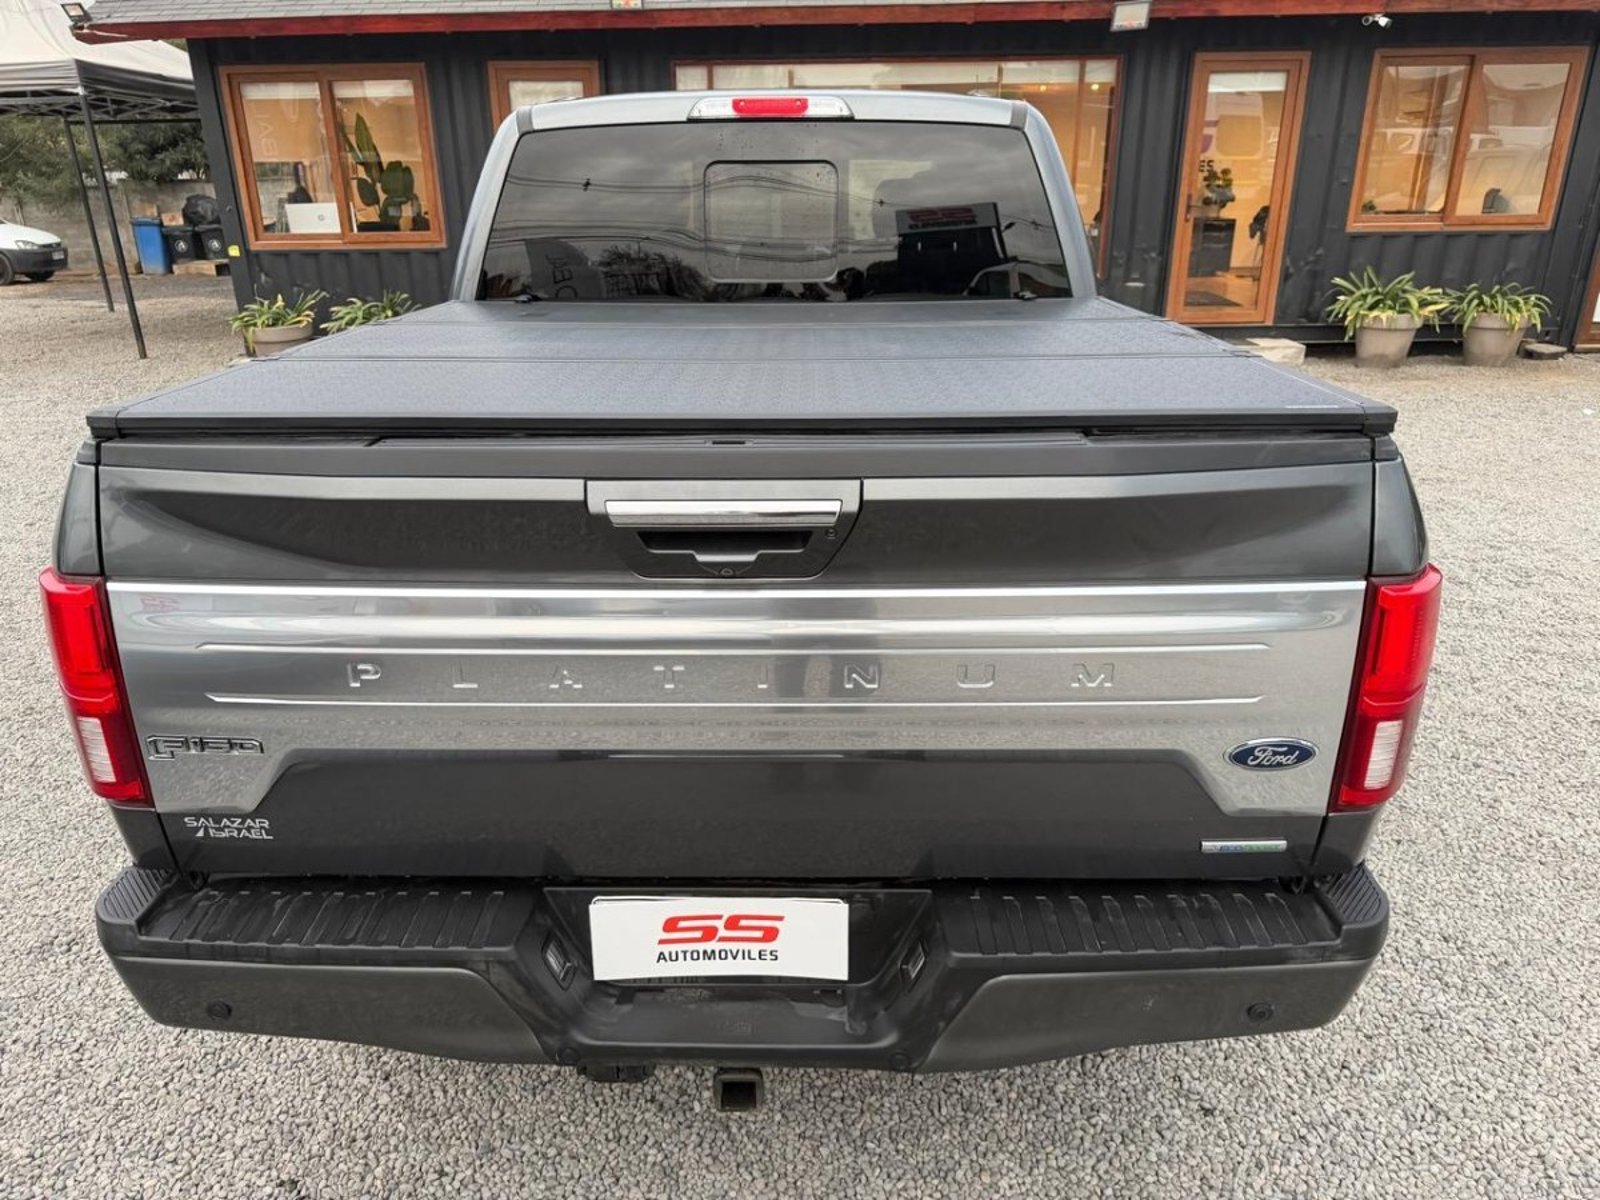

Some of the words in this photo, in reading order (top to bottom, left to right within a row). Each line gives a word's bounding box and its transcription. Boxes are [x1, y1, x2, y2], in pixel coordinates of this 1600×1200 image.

[346, 662, 1115, 689] PLATINUM
[1247, 746, 1300, 766] Ford
[183, 816, 270, 829] SALAZAR
[657, 914, 785, 945] SS
[656, 949, 779, 964] AUTOMOVILES
